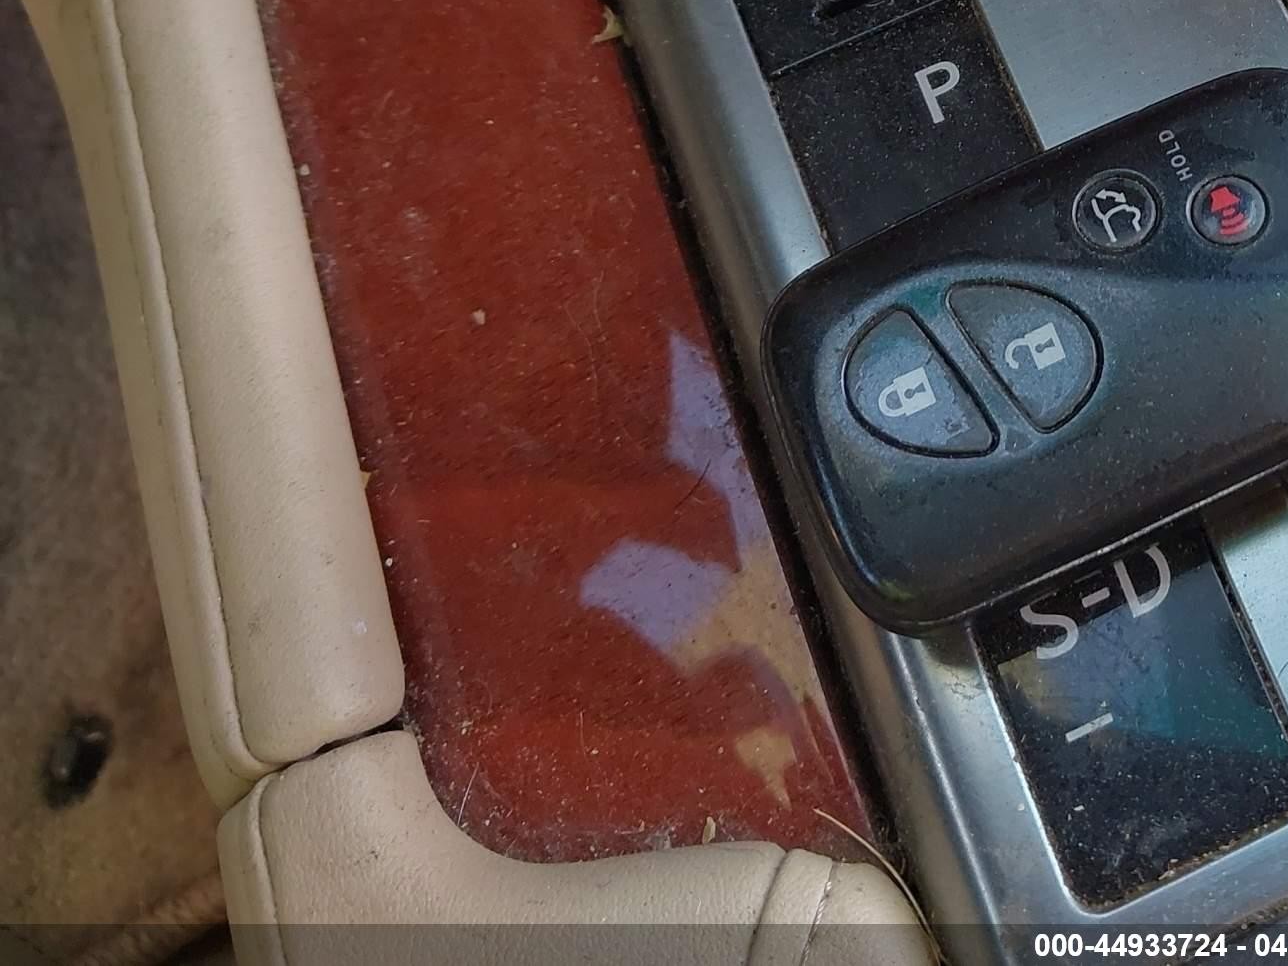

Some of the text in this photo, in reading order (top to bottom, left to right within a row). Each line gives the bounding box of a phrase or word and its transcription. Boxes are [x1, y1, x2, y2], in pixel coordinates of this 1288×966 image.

[914, 60, 961, 124] P
[1157, 129, 1193, 182] HOLD
[1019, 542, 1171, 660] S-D
